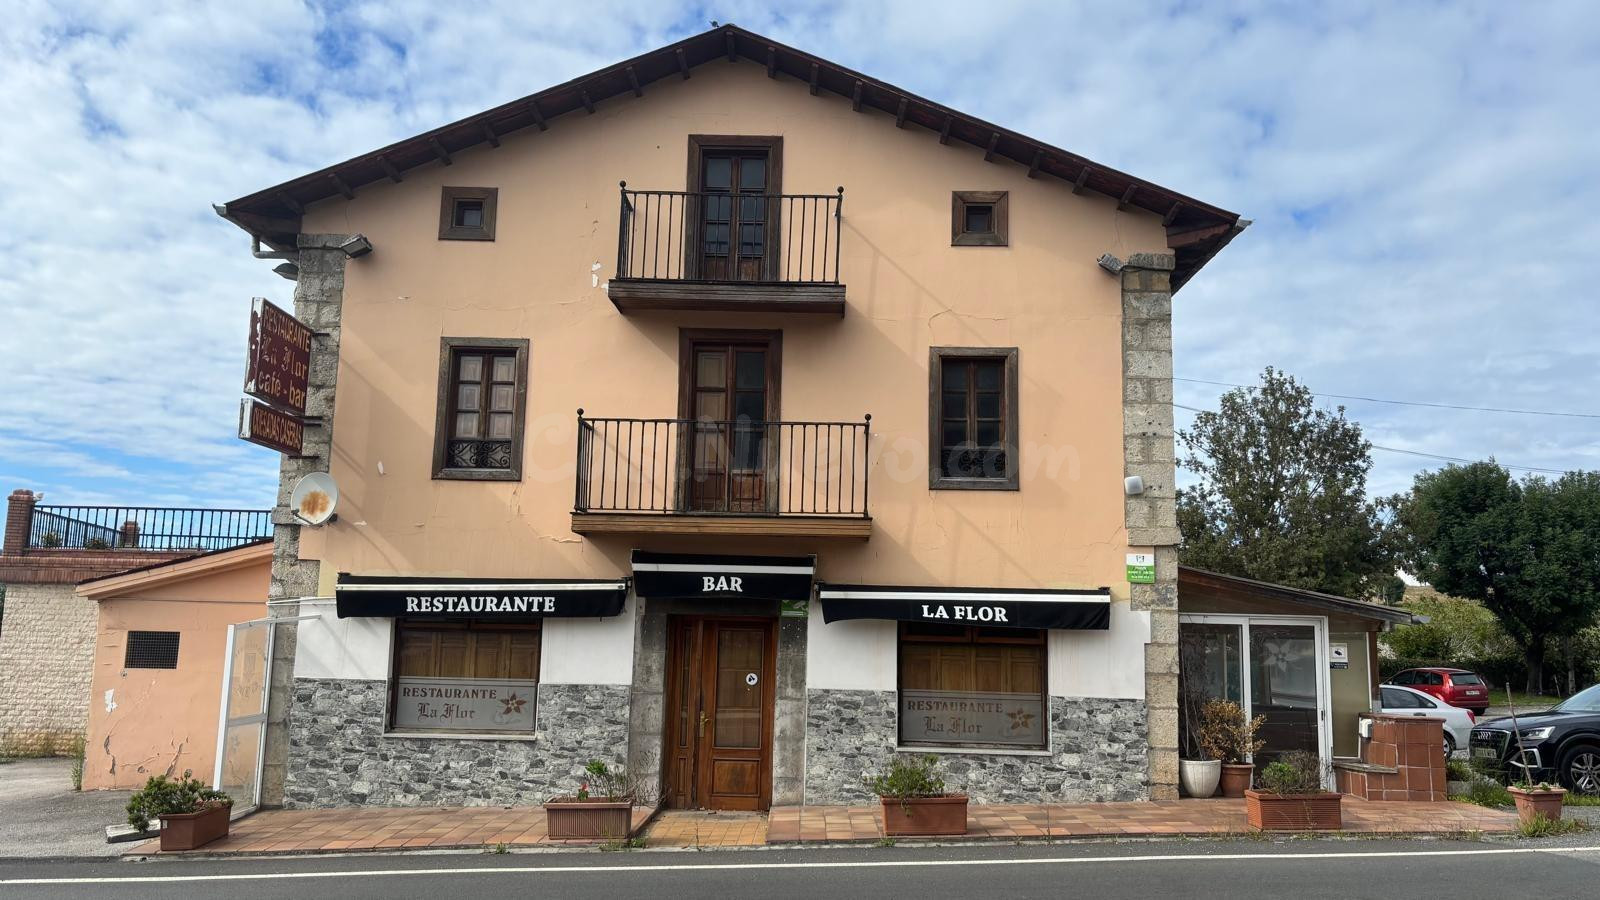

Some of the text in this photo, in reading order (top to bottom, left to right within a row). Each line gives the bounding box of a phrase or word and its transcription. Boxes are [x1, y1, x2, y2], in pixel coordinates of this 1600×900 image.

[263, 306, 310, 352] RESTAURANTE
[289, 380, 305, 409] bar
[702, 576, 743, 592] BAR
[406, 596, 556, 612] RESTAURANTE
[922, 604, 1008, 622] LA FLOR
[402, 687, 497, 699] RESTAURANTE
[417, 702, 476, 723] La Flor
[907, 701, 1004, 713] RESTAURANTE
[923, 716, 983, 738] La Flor
